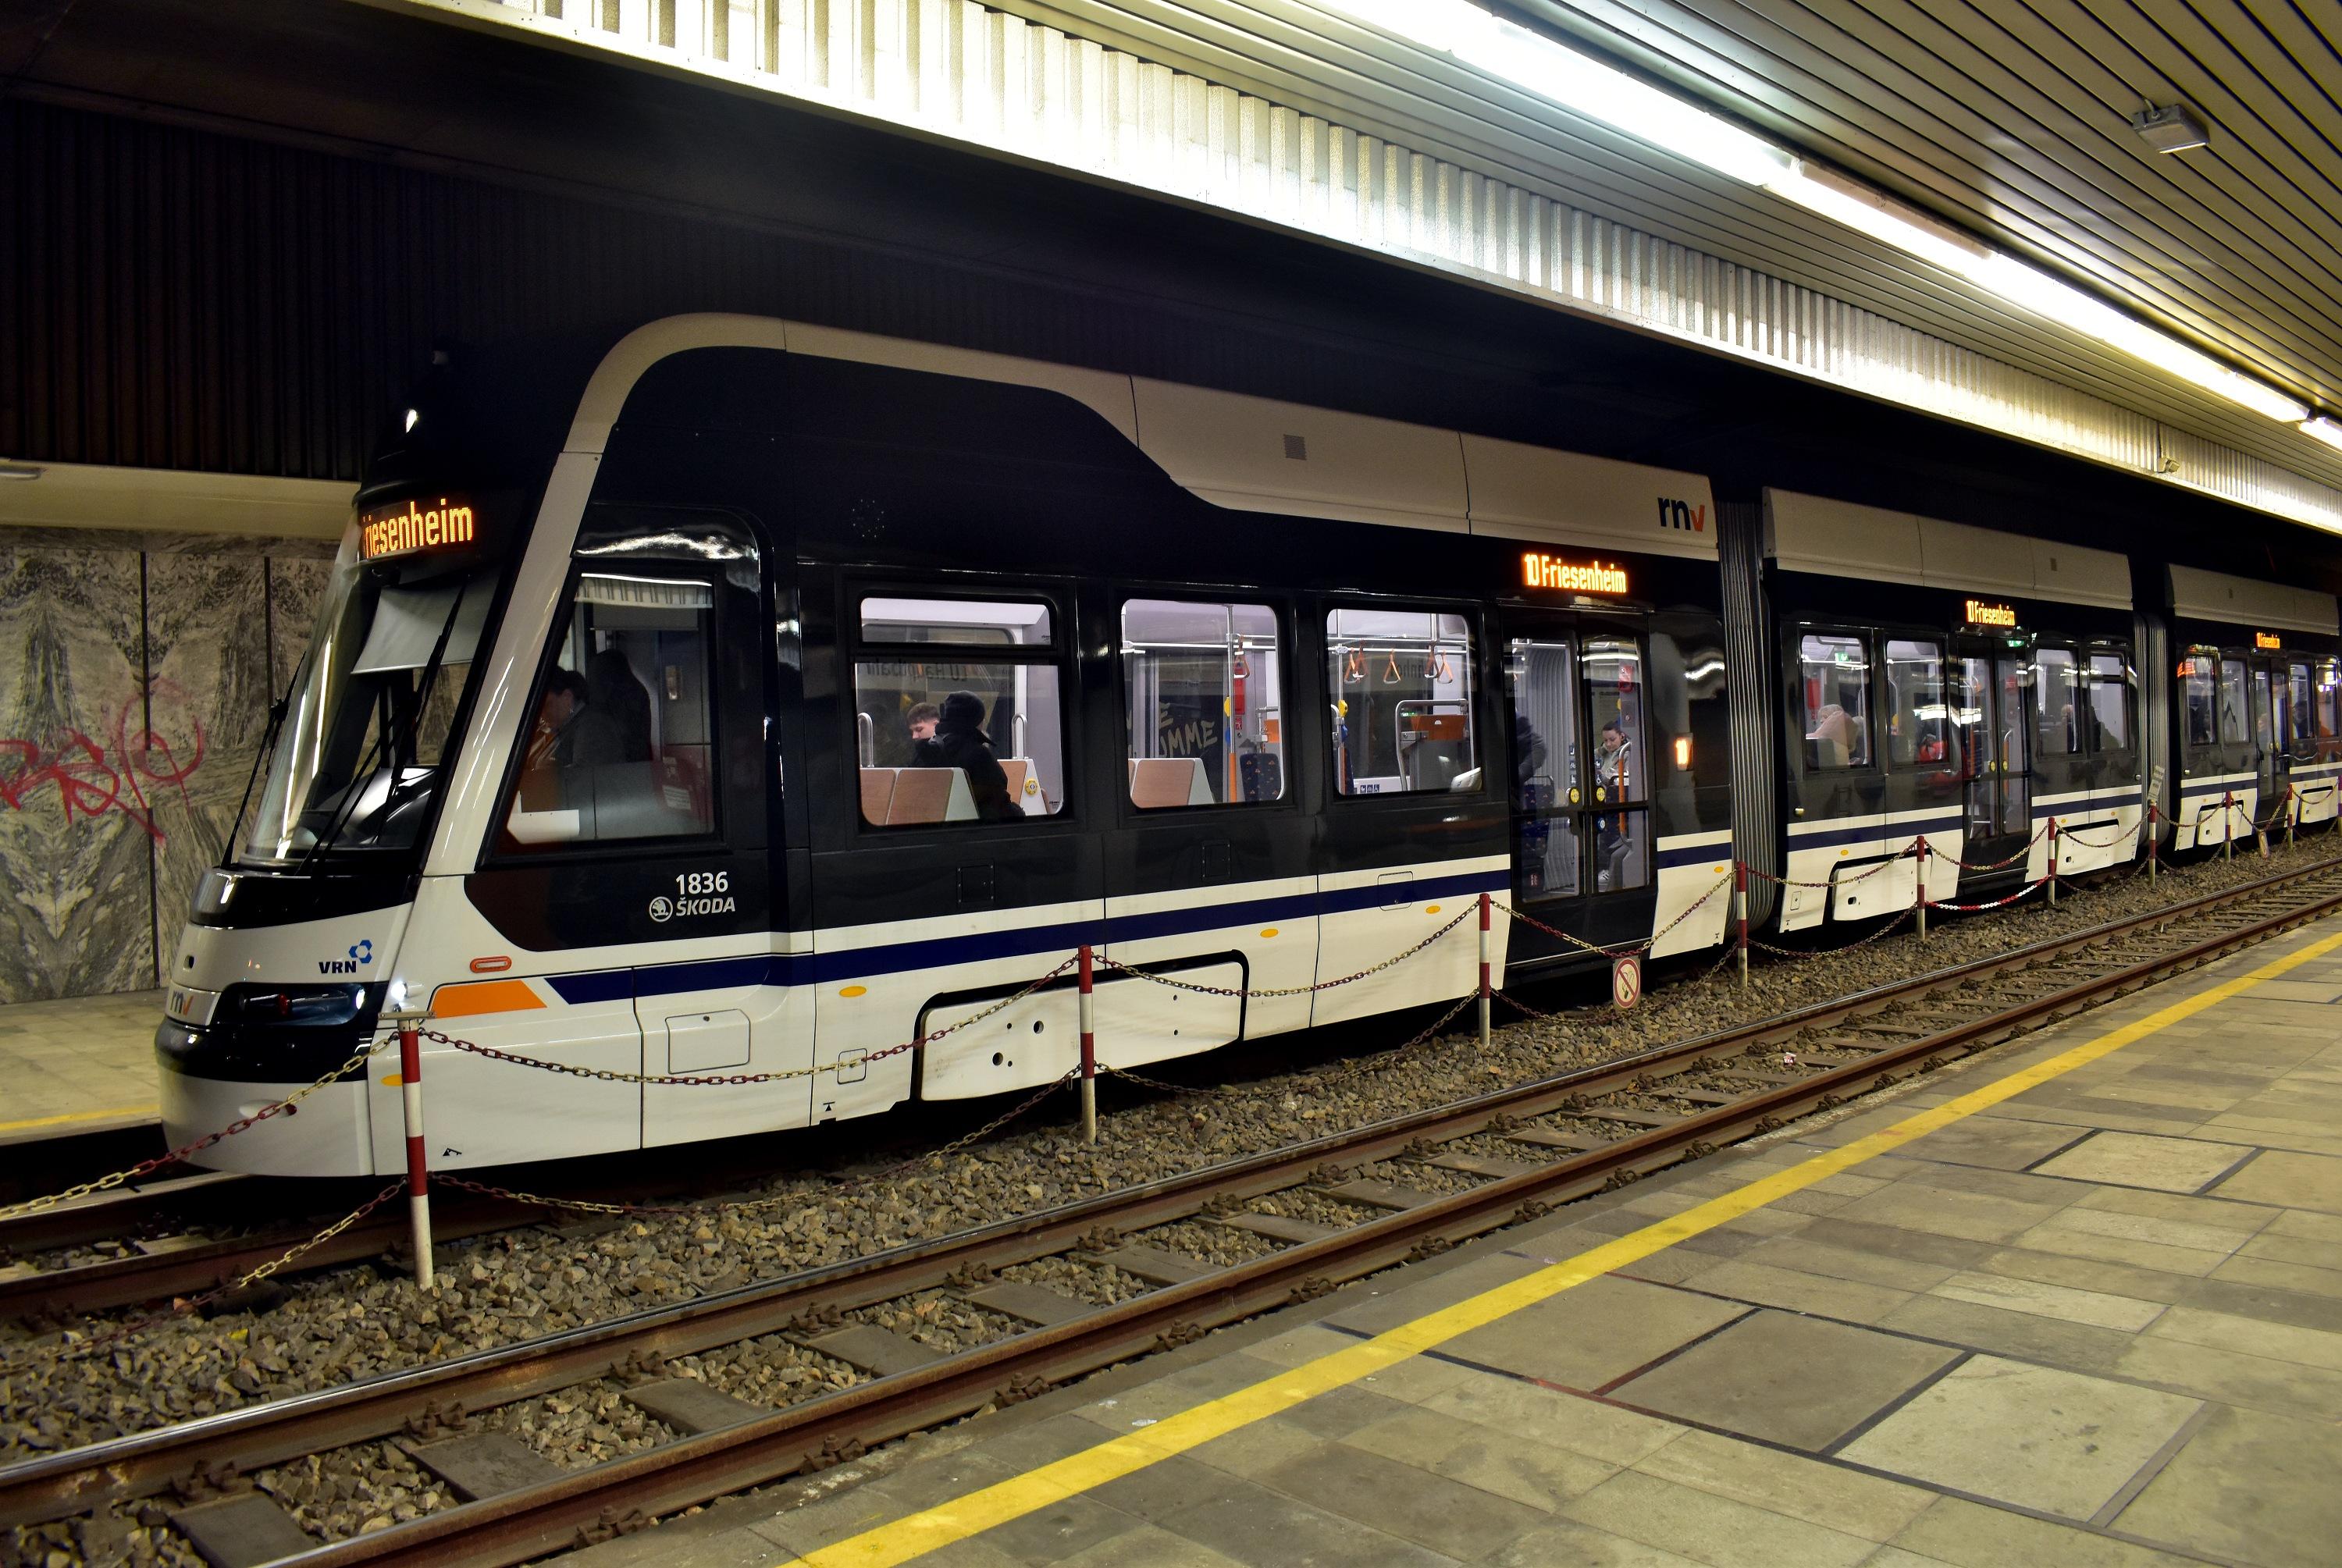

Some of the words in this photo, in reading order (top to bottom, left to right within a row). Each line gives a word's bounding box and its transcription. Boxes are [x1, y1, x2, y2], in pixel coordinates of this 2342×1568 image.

[1657, 497, 1706, 532] rnv
[363, 498, 473, 559] riesenheim
[1524, 553, 1539, 586] 10
[1541, 555, 1627, 593] Friesenheim
[1974, 600, 2016, 626] Friesenheim
[675, 871, 728, 895] 1836
[675, 897, 736, 917] ŠKODA
[319, 960, 357, 974] VRN
